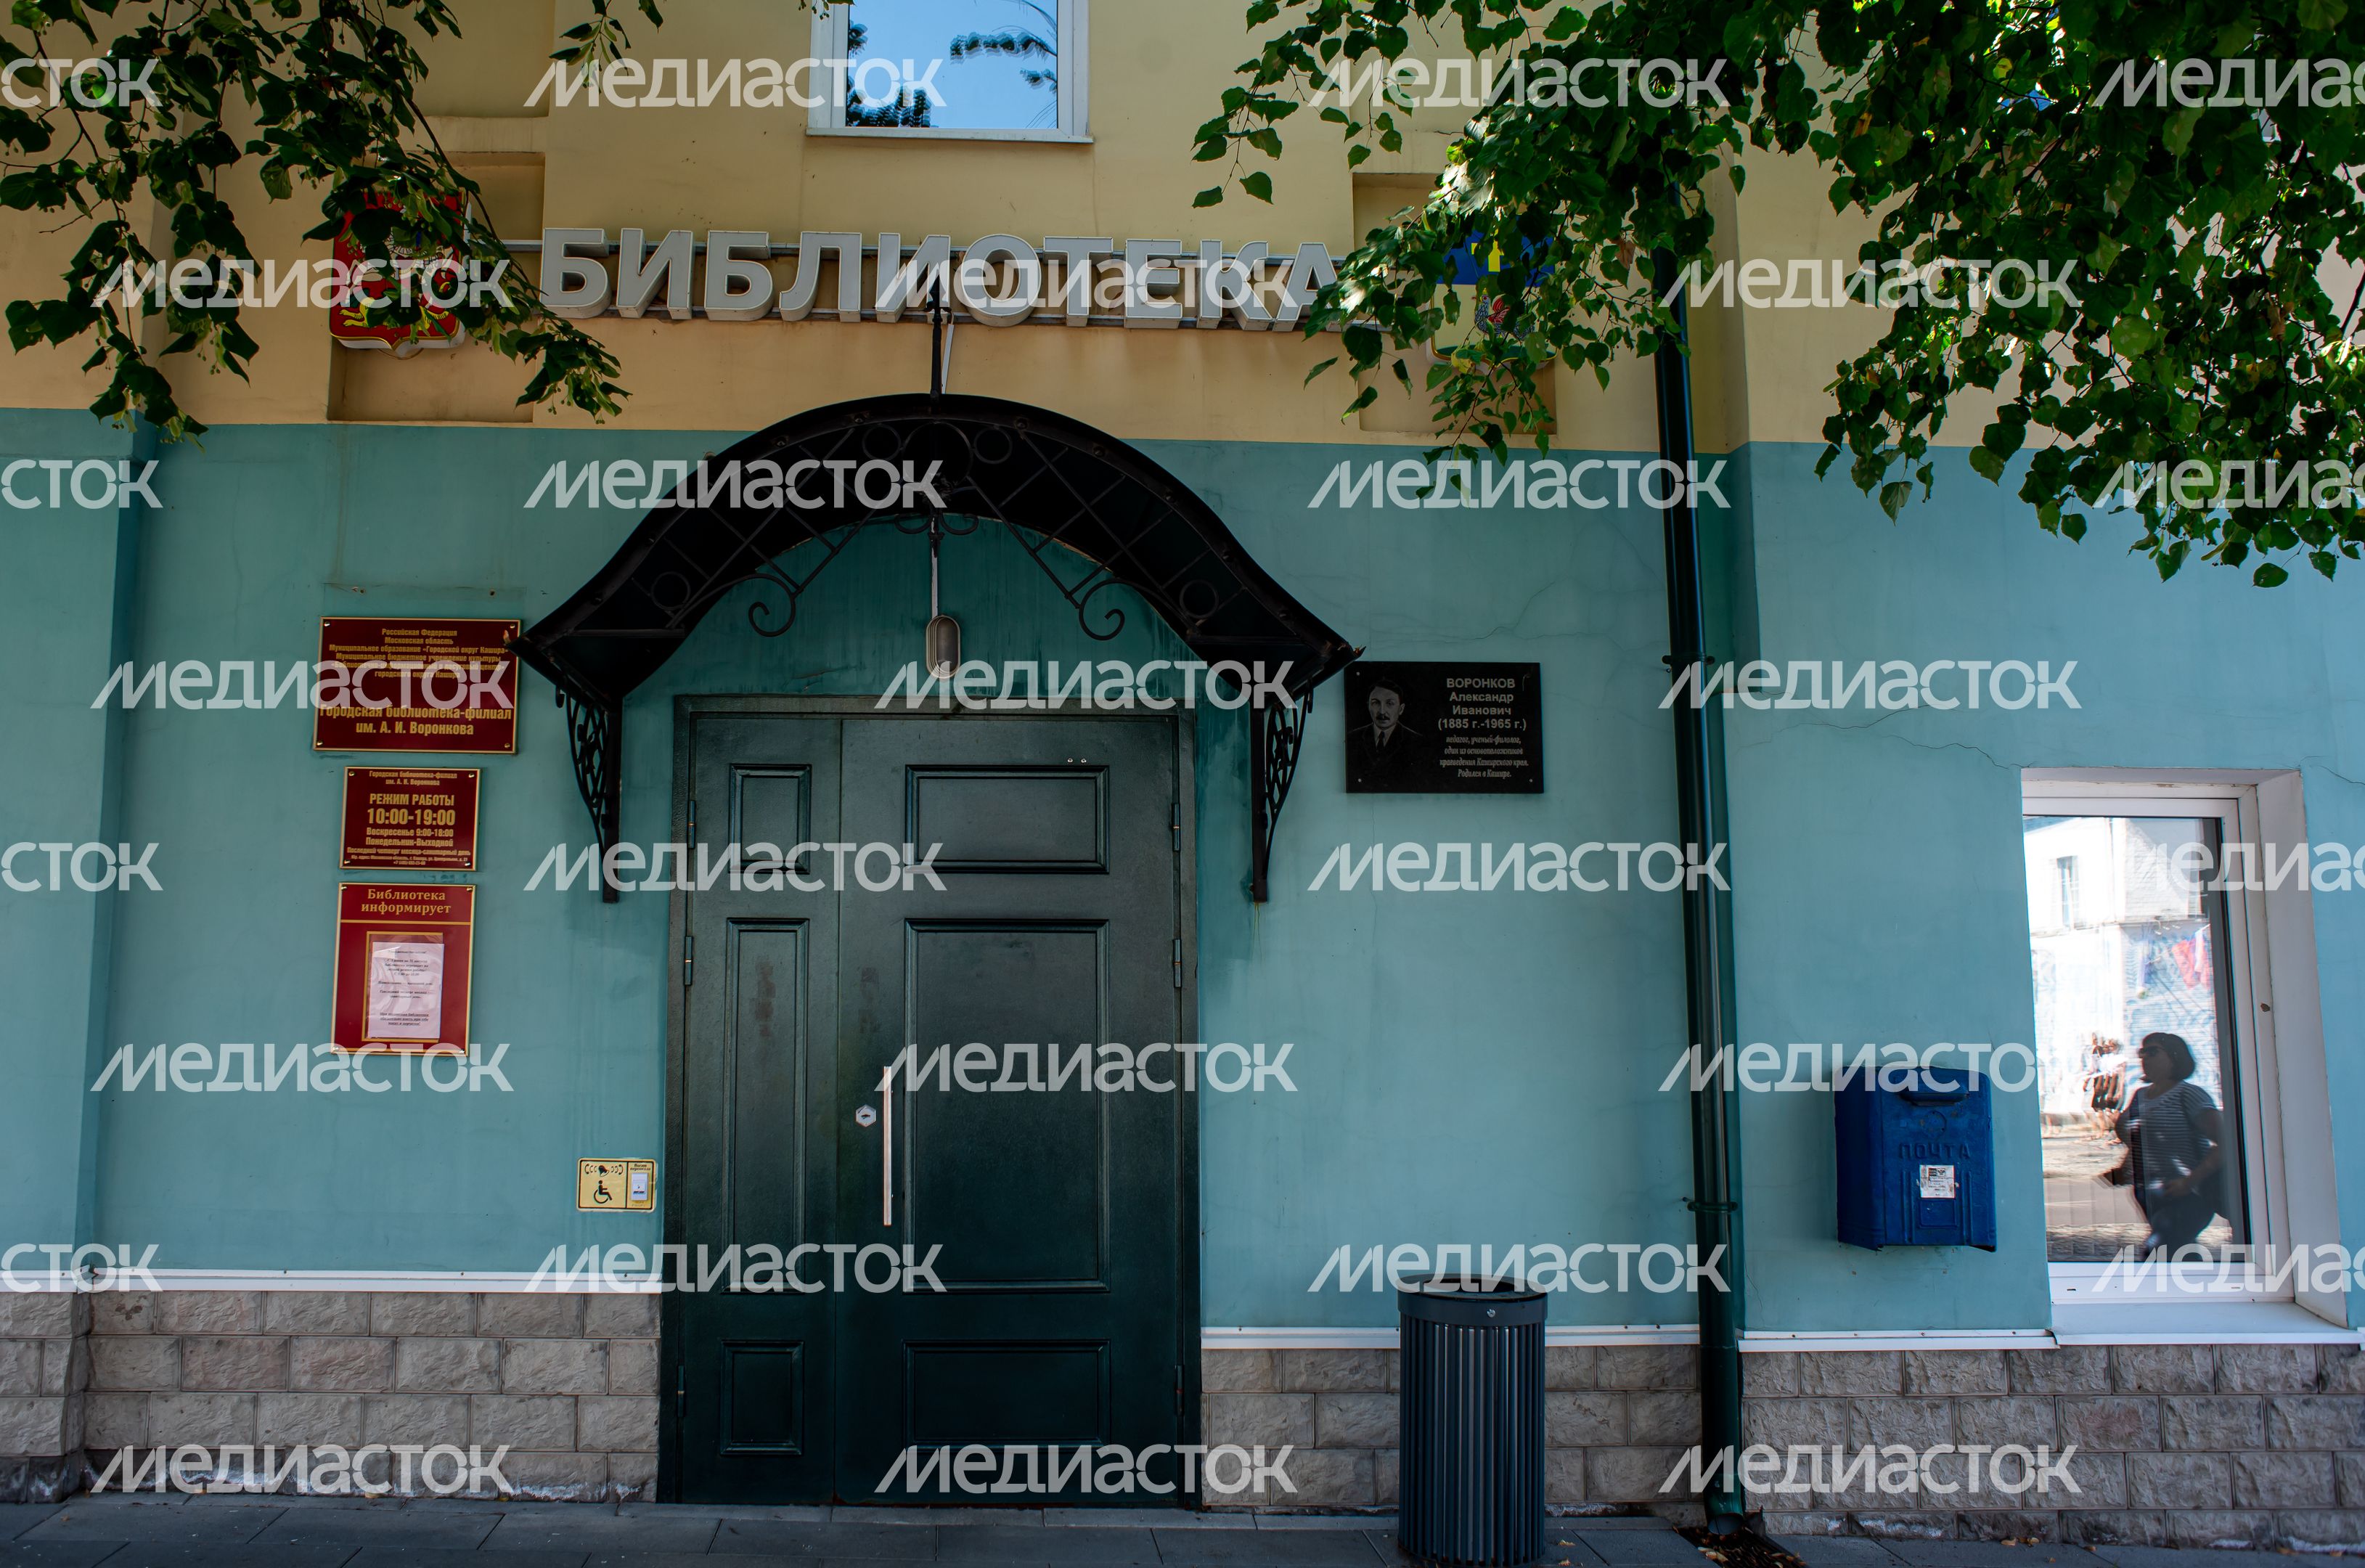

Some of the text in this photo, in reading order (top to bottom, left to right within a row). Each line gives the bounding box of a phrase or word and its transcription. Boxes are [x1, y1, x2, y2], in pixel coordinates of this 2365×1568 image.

[541, 226, 1357, 332] БИБЛИОТЕКА
[1447, 678, 1515, 688] ВОРОНКОВ
[1449, 692, 1514, 703] Александр
[320, 704, 512, 721] Городская библиотека-филиал
[1453, 704, 1511, 715] Иванович
[356, 722, 474, 736] им. А. И. Воронкова
[1438, 719, 1527, 730] (1885 г.-1965 г.)
[1458, 769, 1482, 777] Родился
[369, 793, 454, 806] РЕЖИМ РАБОТЫ
[367, 808, 456, 825] 10:00-19:00
[367, 828, 454, 837] Воскресенье 9:00-18:00
[366, 837, 454, 846] Понедельник-Выходной
[367, 889, 446, 900] Библиотека
[361, 902, 452, 915] информирует
[1899, 1143, 1971, 1159] ПОЧТА
